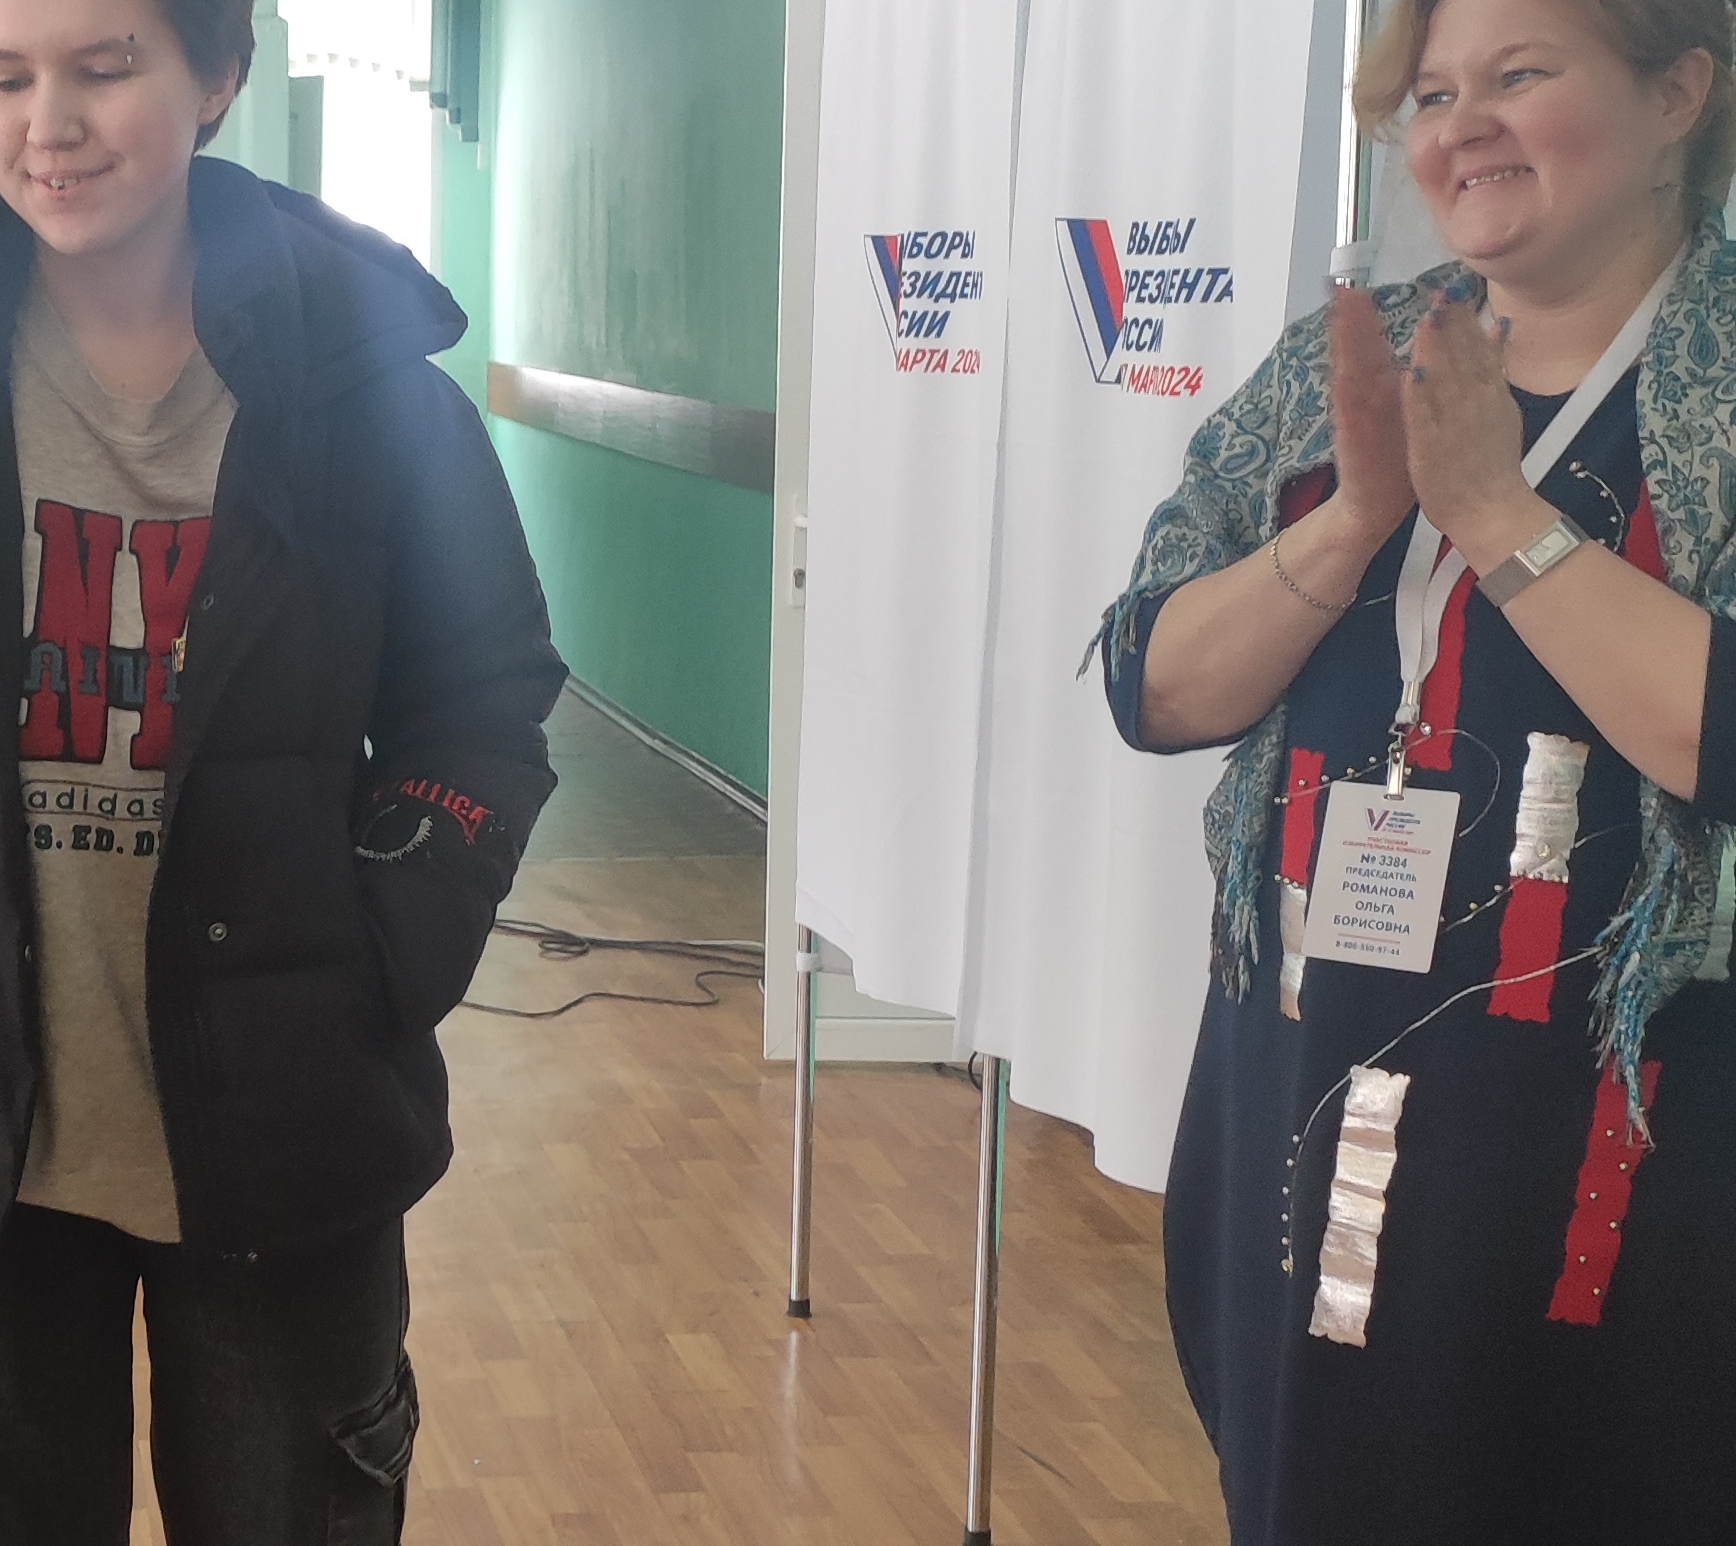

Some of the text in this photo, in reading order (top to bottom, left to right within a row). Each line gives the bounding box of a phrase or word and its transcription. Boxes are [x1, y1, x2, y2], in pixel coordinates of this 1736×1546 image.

[28, 786, 165, 818] adidas
[72, 824, 124, 855] ED.
[133, 829, 162, 857] D
[1379, 855, 1408, 868] 3384
[1345, 866, 1417, 882] ПРЕДСЕДАТЕЛЬ
[1342, 881, 1415, 900] РОМАНОВА
[1355, 900, 1395, 915] ОЛЬГА
[1333, 914, 1411, 934] БОРИСОВНА
